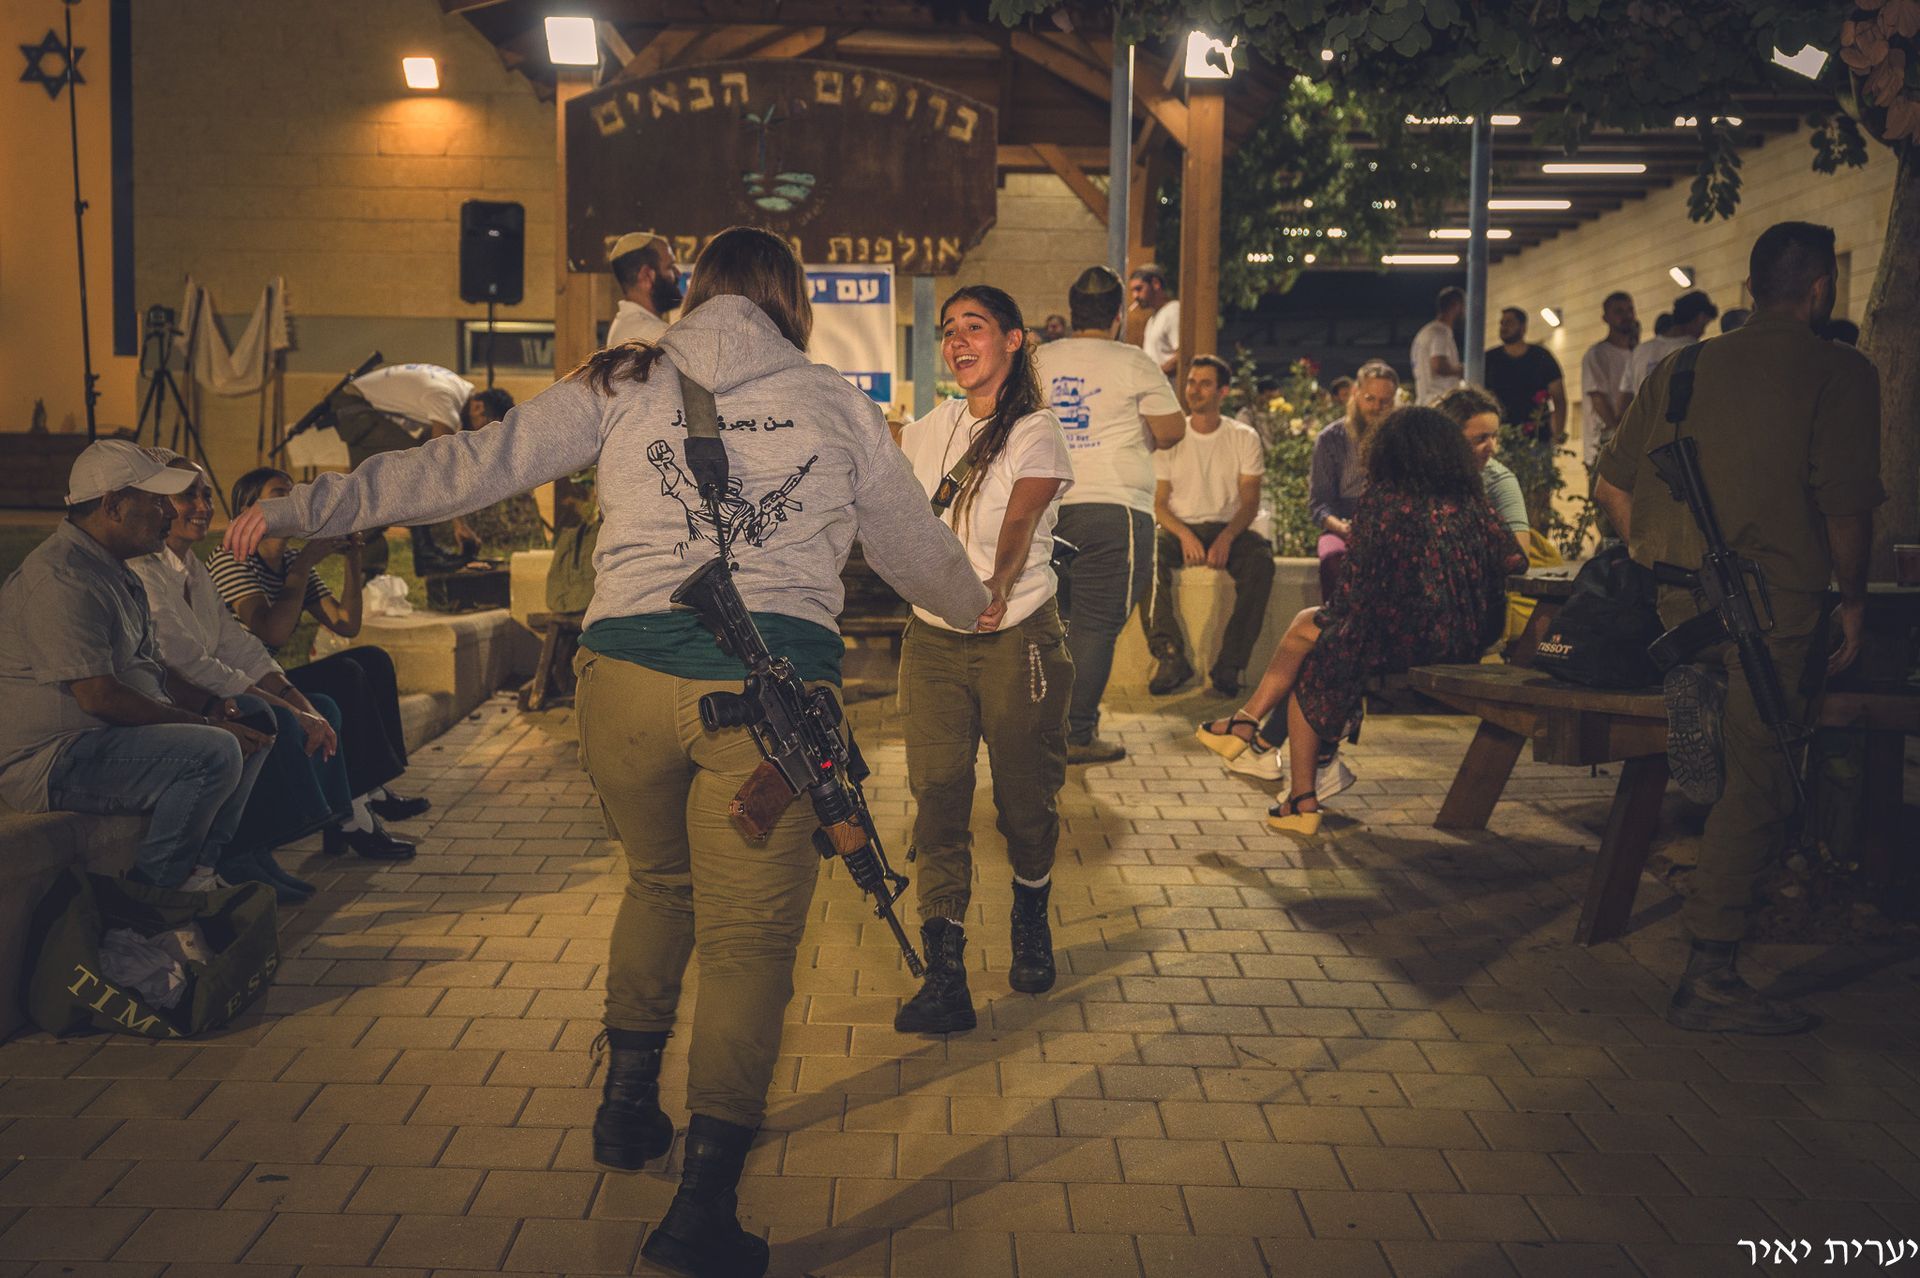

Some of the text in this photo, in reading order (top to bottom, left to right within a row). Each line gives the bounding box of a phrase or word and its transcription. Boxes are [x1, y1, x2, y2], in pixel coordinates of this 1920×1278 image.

[590, 71, 749, 137] הבאים
[827, 231, 961, 265] אולפנת
[836, 279, 880, 302] עם
[763, 415, 795, 432] من
